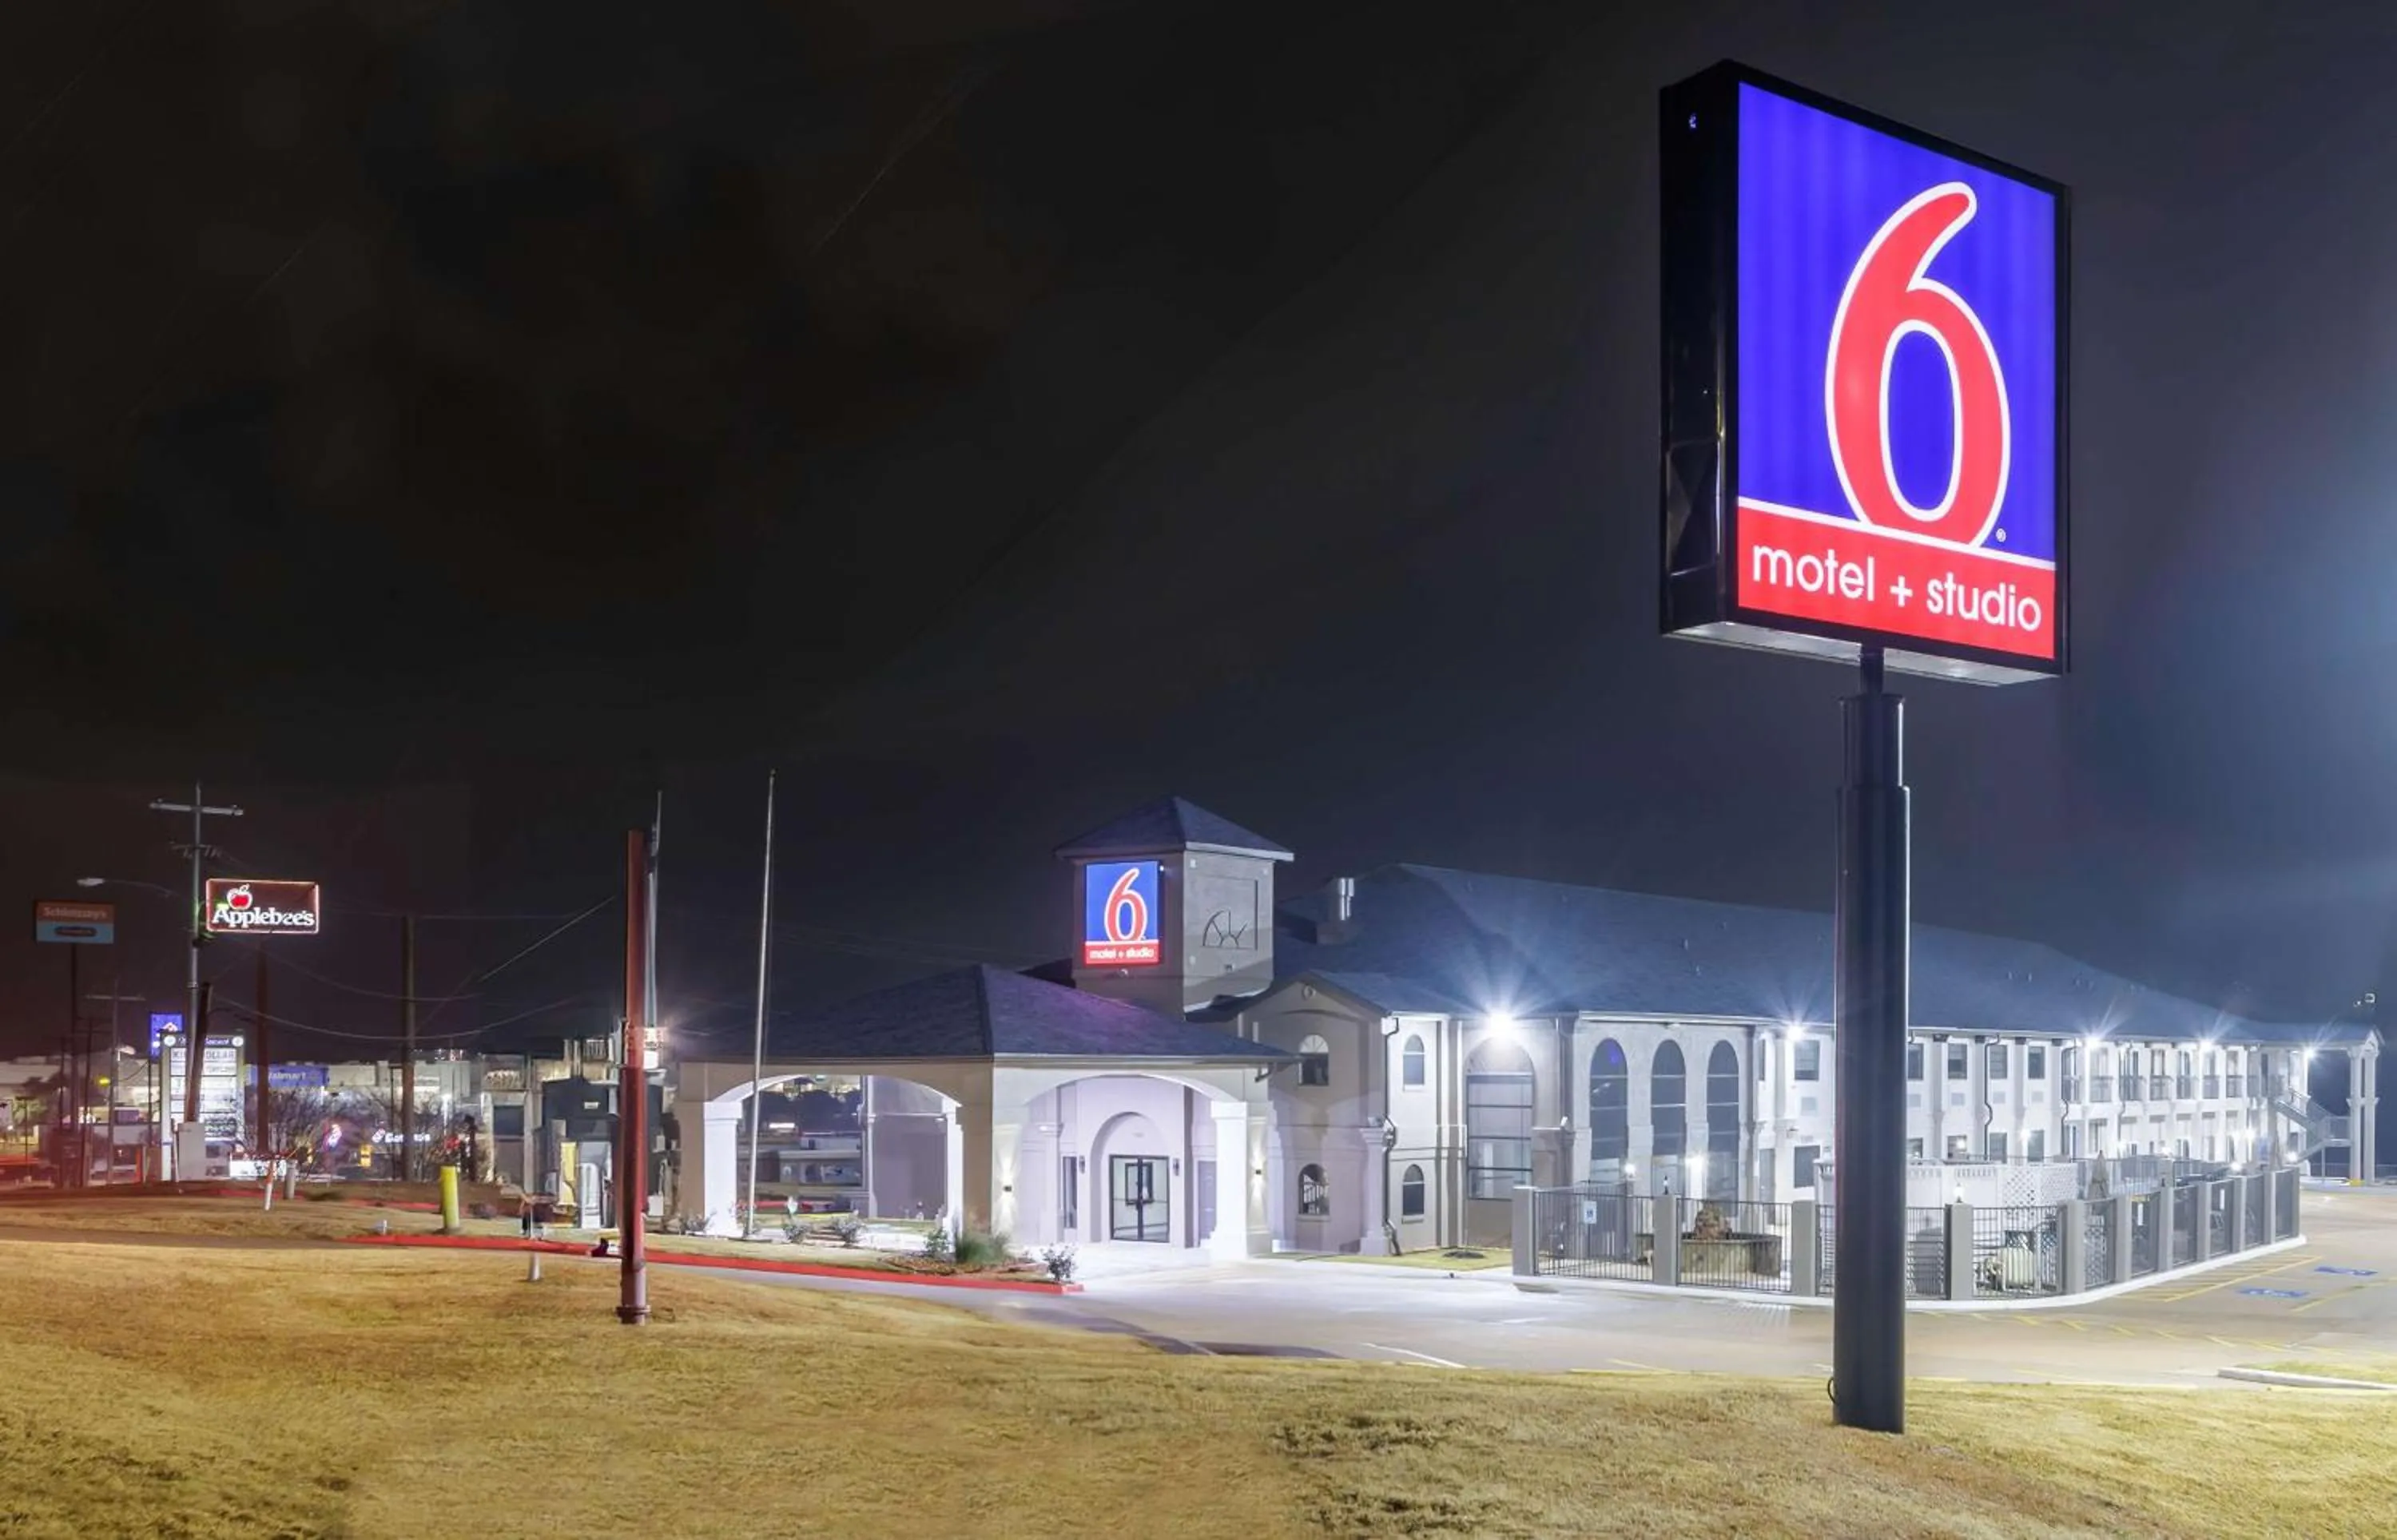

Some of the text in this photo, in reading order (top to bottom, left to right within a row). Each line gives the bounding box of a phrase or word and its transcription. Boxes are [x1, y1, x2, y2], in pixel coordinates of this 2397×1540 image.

[1825, 181, 2011, 549] 6
[1753, 545, 2041, 631] motel + studio
[212, 906, 315, 928] Applebee's
[1104, 867, 1148, 943] 6
